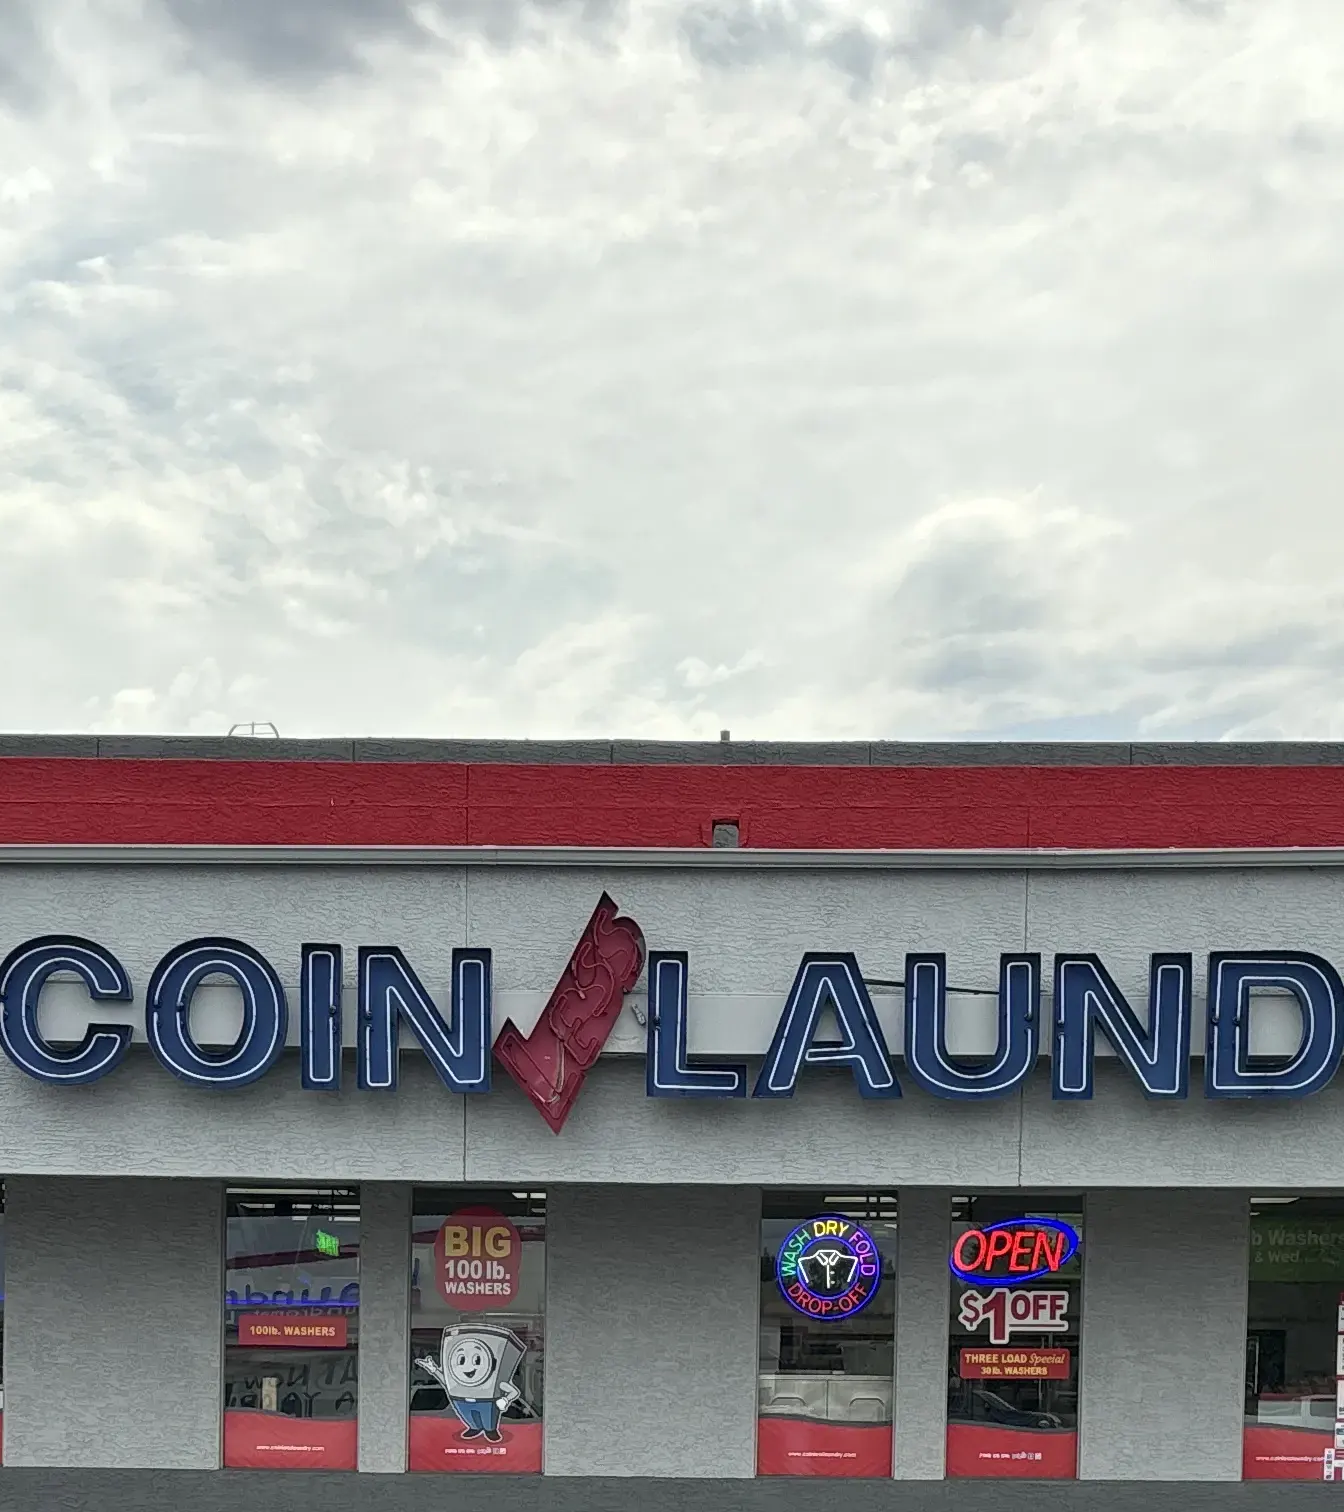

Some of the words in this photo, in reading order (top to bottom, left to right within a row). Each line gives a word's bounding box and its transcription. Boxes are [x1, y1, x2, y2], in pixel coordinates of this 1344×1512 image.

[445, 1226, 511, 1258] BIG
[781, 1229, 812, 1277] WASH
[813, 1220, 850, 1237] DRY
[848, 1231, 876, 1276] FOLD
[954, 1230, 1065, 1271] OPEN
[445, 1260, 482, 1279] 100
[486, 1260, 511, 1280] lb.
[445, 1281, 511, 1295] WASHERS
[787, 1282, 867, 1315] DROP-OFF
[962, 1291, 1006, 1341] $1
[1010, 1294, 1065, 1321] OFF
[284, 1326, 336, 1336] WASHERS
[965, 1354, 999, 1363] THREE
[1001, 1354, 1028, 1363] LOAD
[1029, 1353, 1065, 1366] Special
[1005, 1367, 1048, 1375] WASHERS
